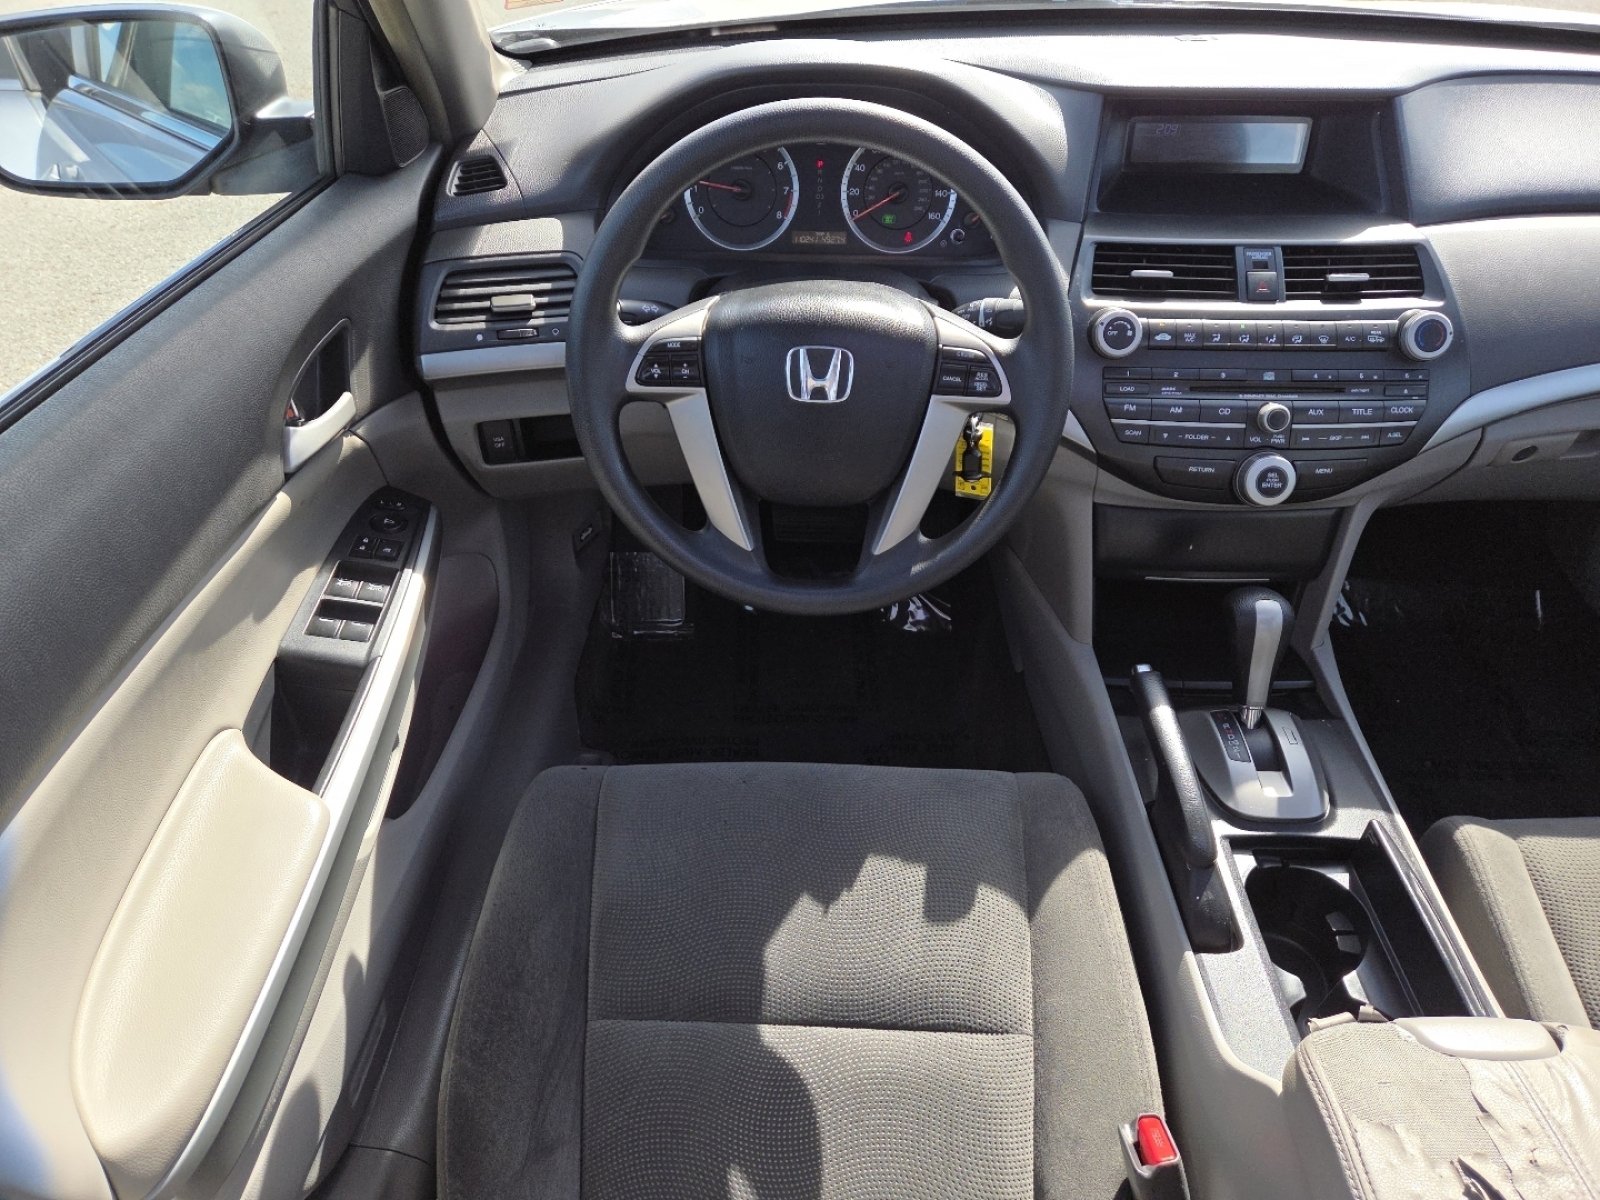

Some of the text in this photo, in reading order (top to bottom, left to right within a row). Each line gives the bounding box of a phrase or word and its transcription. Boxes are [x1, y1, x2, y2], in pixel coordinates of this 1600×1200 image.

[777, 162, 784, 170] 6
[854, 164, 866, 172] 40
[783, 186, 790, 195] 7
[849, 188, 860, 196] 20
[934, 190, 948, 198] 140
[698, 206, 704, 214] 0
[776, 211, 783, 220] 8
[928, 212, 941, 220] 160
